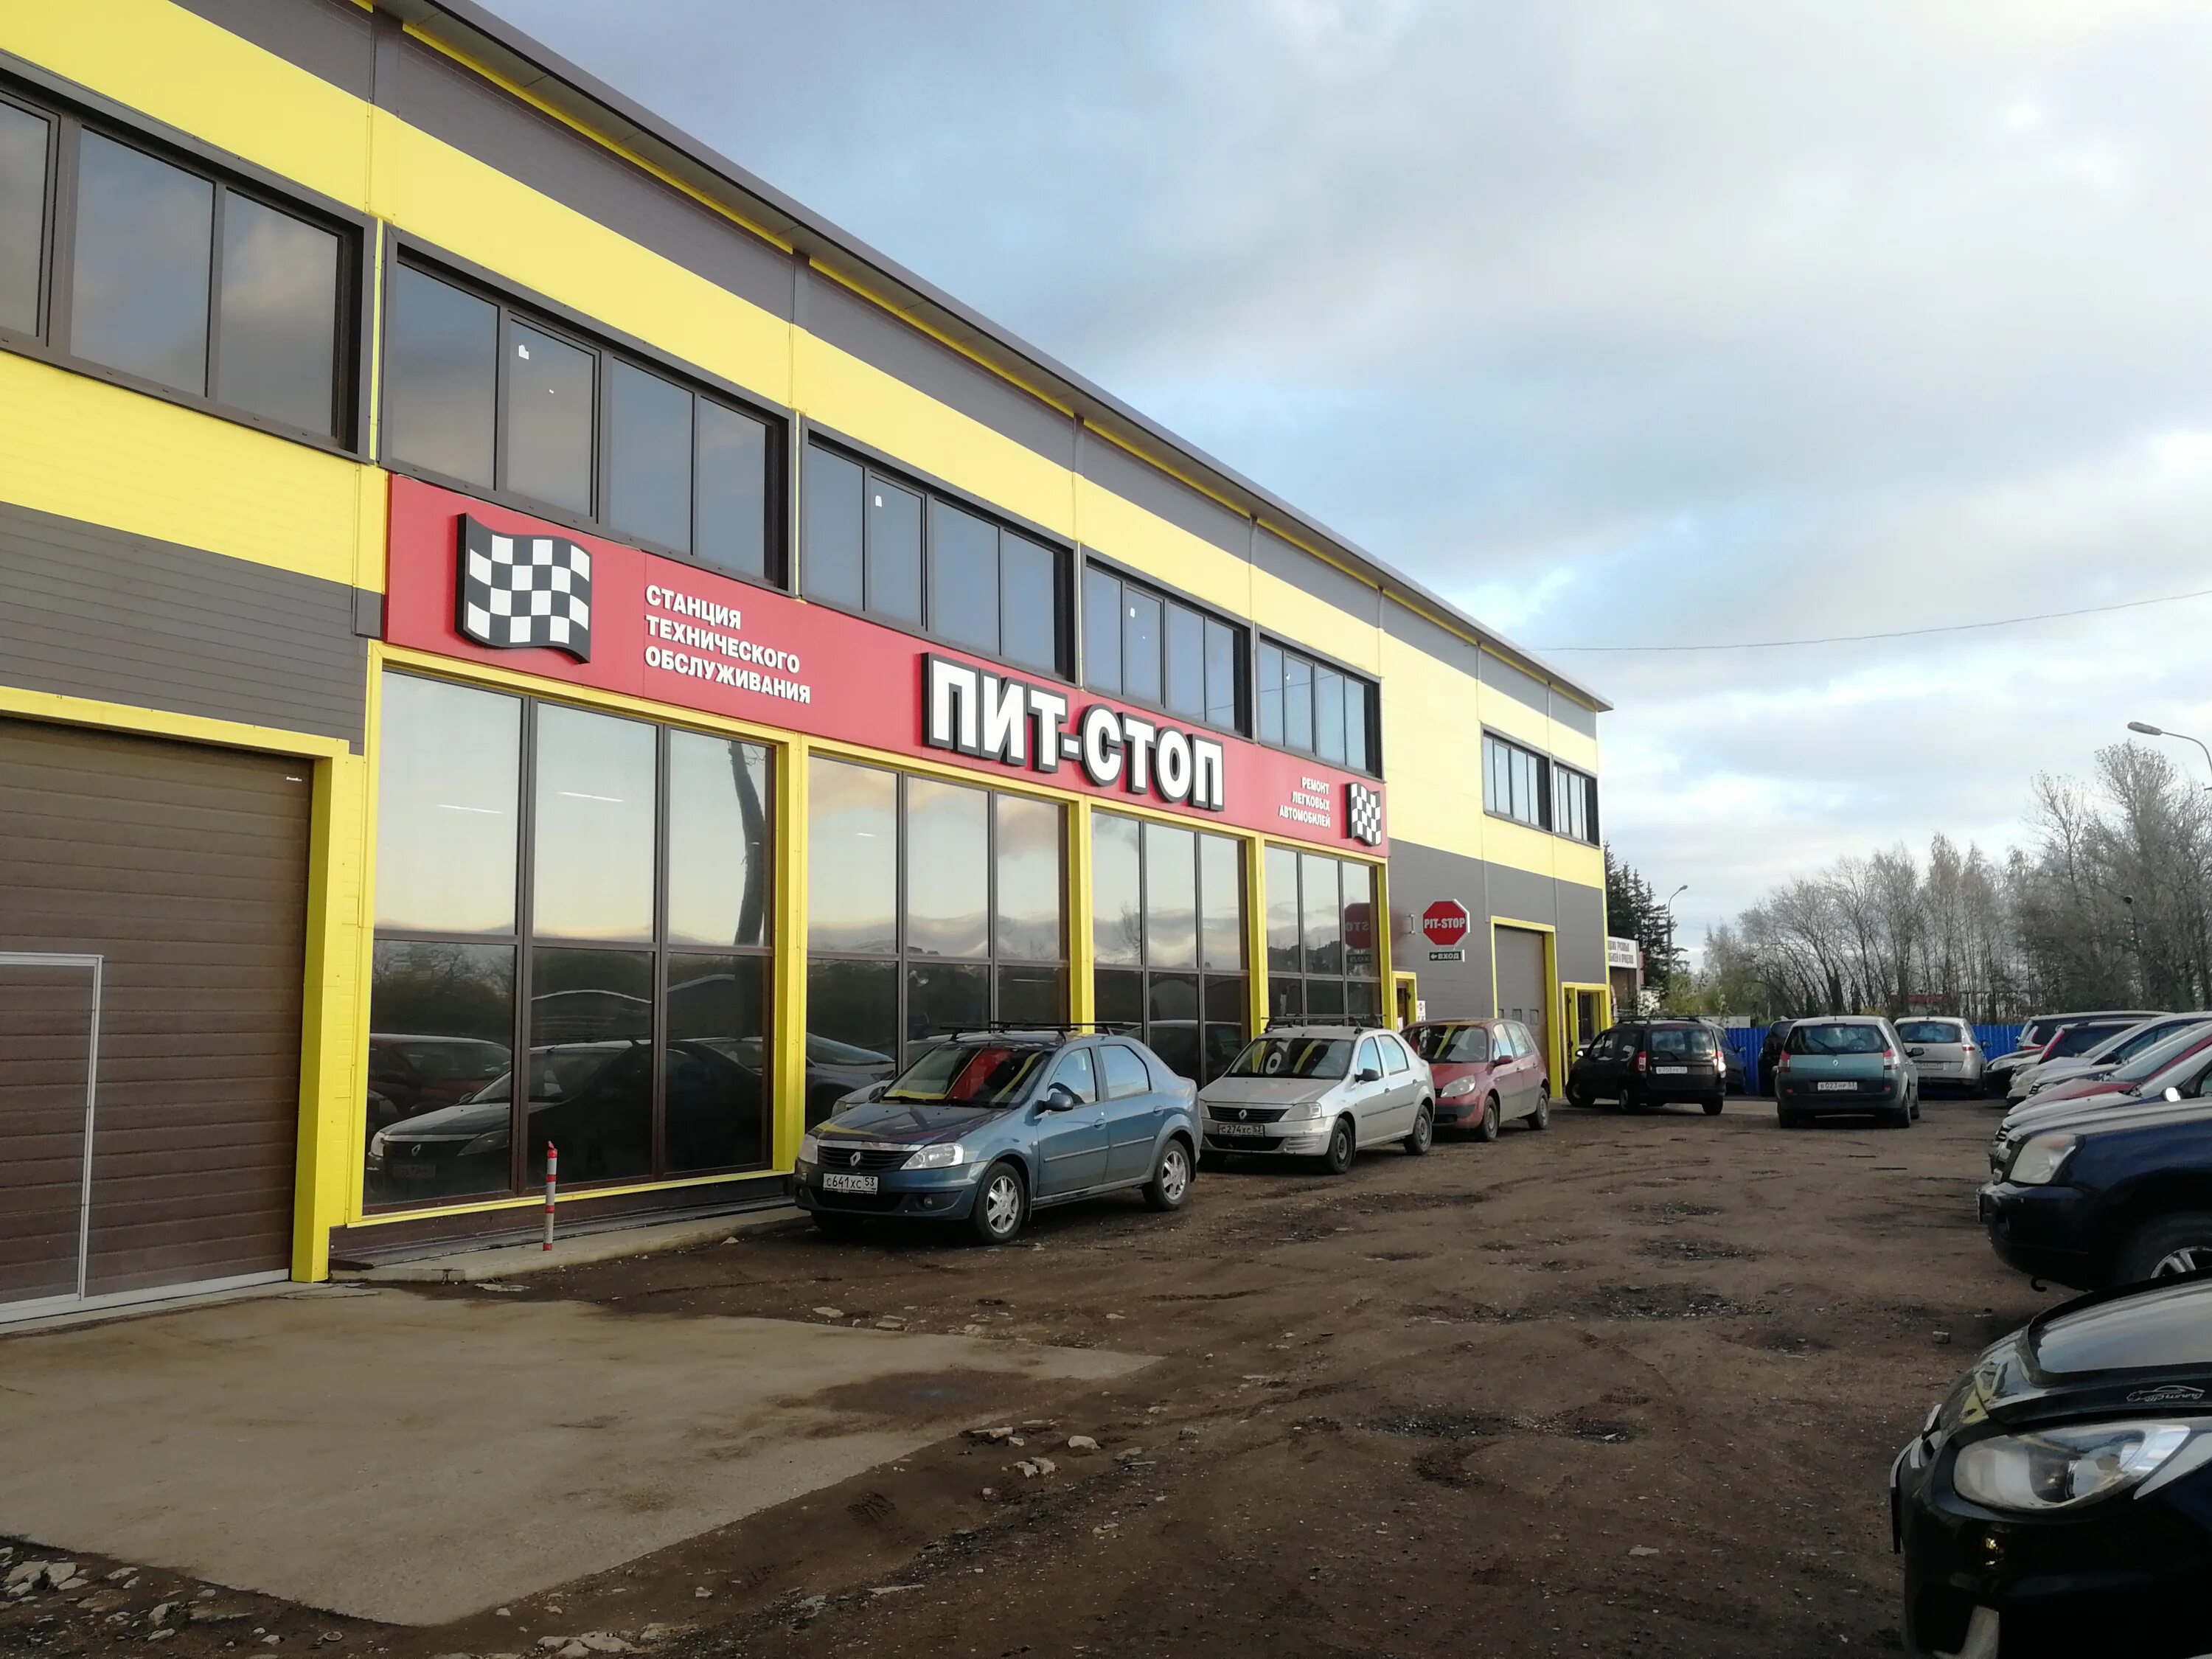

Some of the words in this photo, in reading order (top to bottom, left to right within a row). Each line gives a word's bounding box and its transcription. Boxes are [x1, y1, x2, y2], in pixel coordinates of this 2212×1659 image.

[645, 585, 741, 630] СТАНЦИЯ
[644, 614, 800, 673] ТЕХНИЧЕСКОГО
[644, 646, 810, 704] ОБСЛУЖИВАНИЯ
[923, 653, 1224, 811] ПИТ-СТОП
[1291, 790, 1330, 812] ЛЕГКОВЫХ
[1301, 776, 1329, 795] РЕМОНТ
[1278, 804, 1331, 828] АВТОМОБИЛЕЙ
[1424, 918, 1465, 929] PIT-STOP
